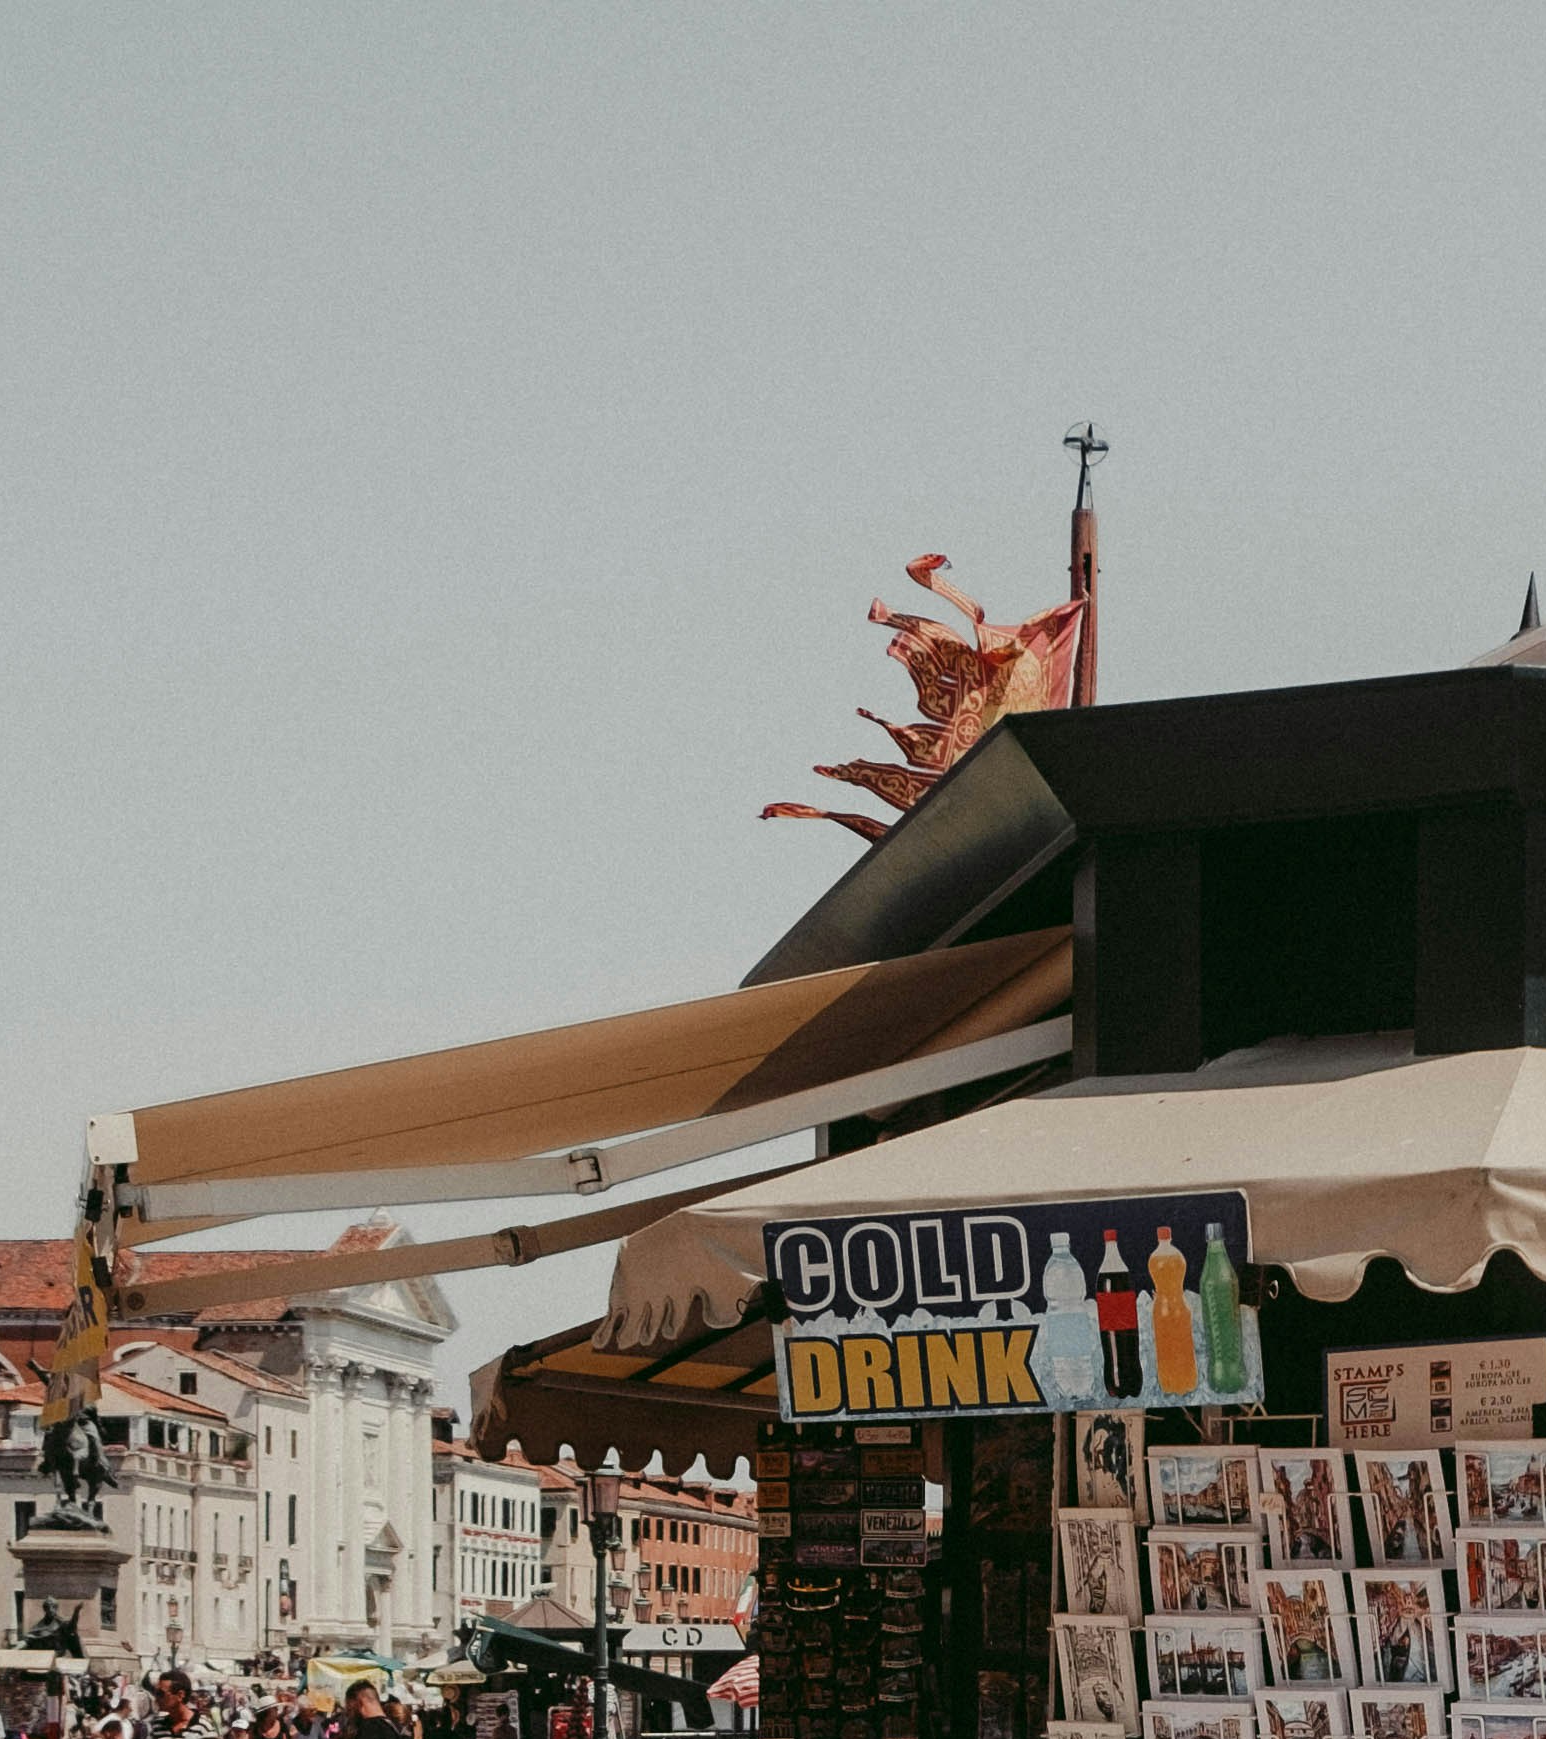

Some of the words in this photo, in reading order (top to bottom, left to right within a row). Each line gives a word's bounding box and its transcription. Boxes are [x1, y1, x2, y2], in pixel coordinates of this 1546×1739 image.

[775, 1215, 1031, 1313] COLD
[787, 1327, 1044, 1414] DRINK
[1334, 1364, 1405, 1381] STAMPS
[1470, 1371, 1503, 1380] EUROPA
[1345, 1424, 1391, 1439] HERE
[662, 1627, 678, 1646] C
[686, 1627, 703, 1646] D
